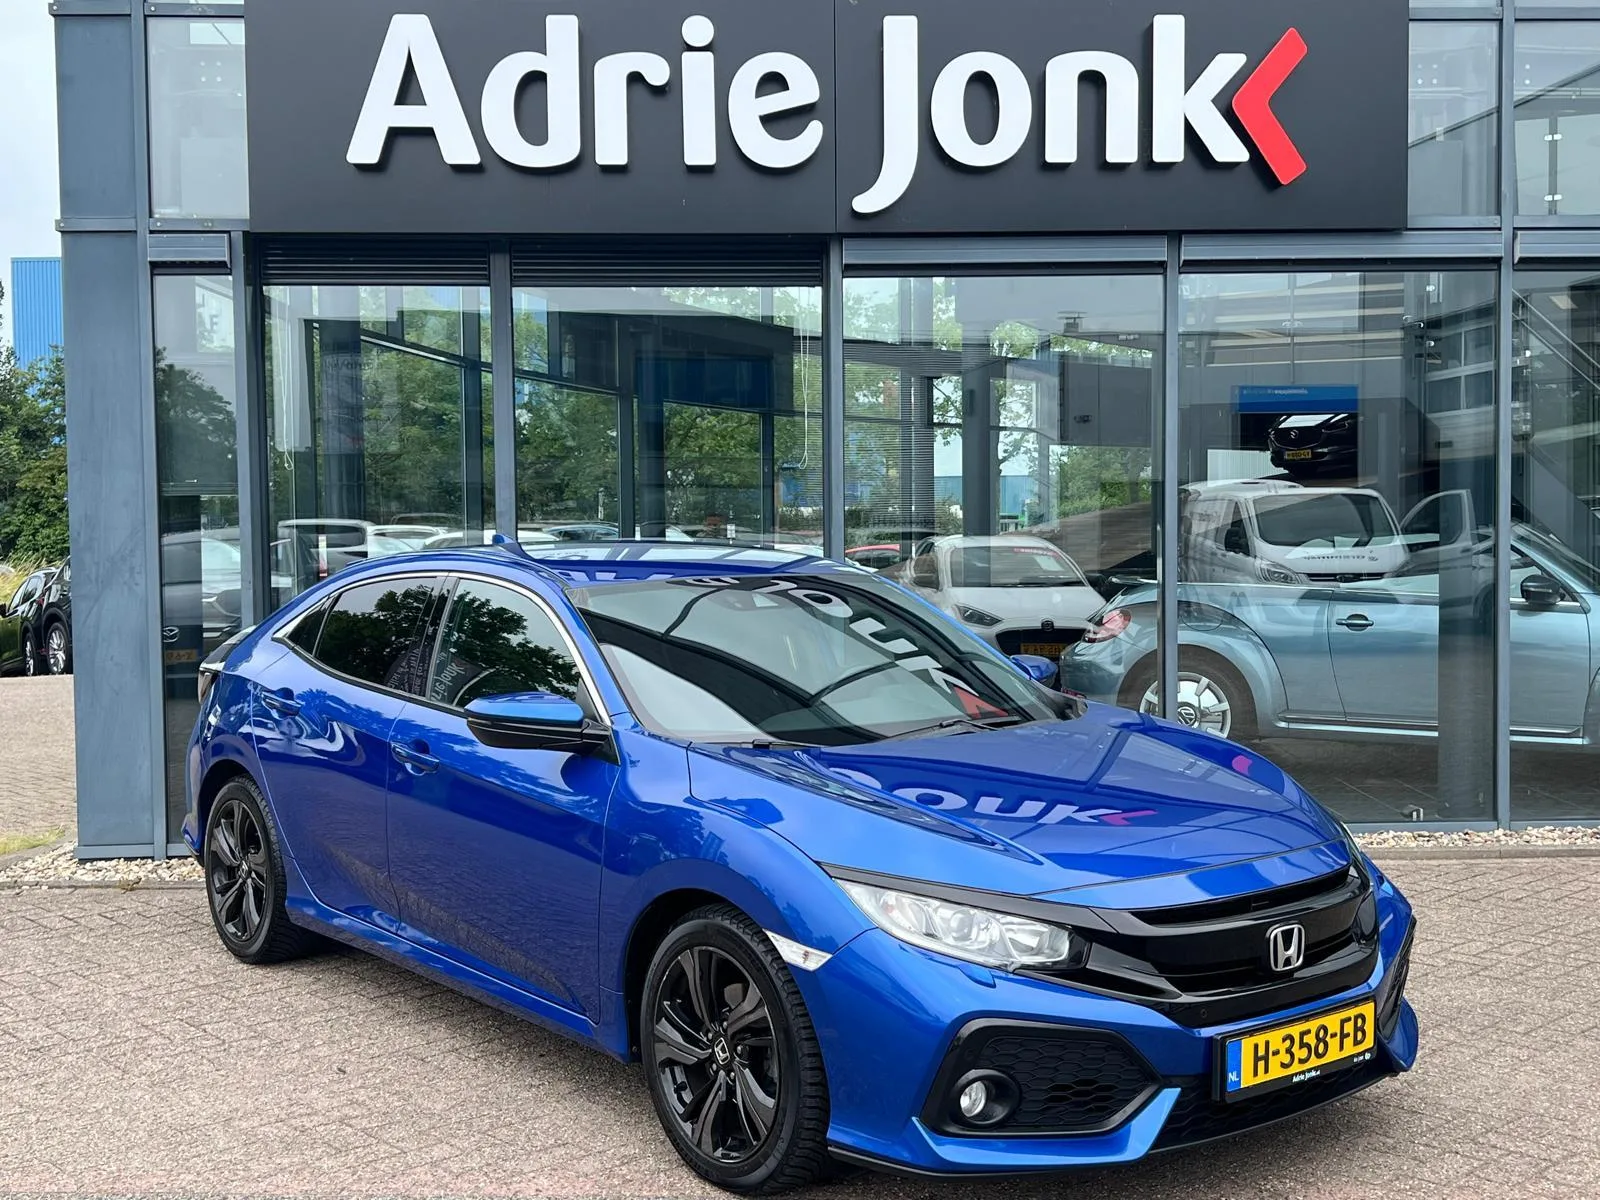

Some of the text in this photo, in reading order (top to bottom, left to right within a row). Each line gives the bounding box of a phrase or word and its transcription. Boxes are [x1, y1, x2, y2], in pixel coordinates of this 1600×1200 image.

[346, 14, 1249, 213] Adrie Jonk
[1228, 1071, 1240, 1083] NL
[1252, 1013, 1367, 1077] H-358-FB
